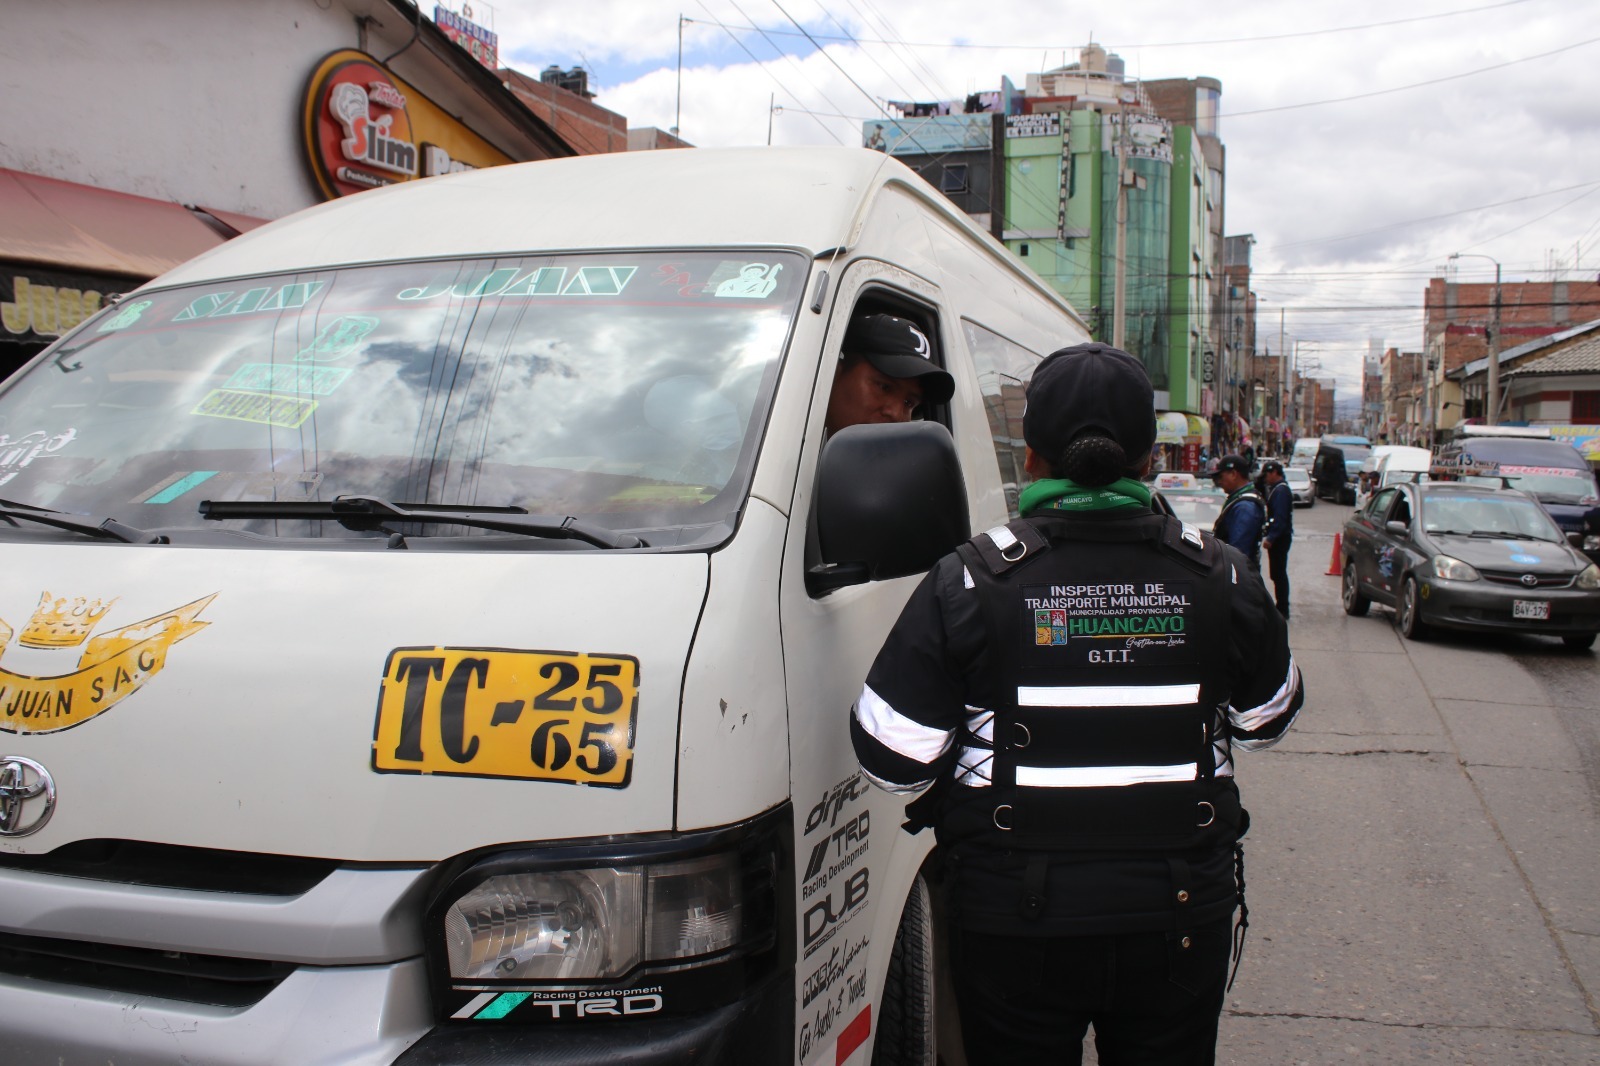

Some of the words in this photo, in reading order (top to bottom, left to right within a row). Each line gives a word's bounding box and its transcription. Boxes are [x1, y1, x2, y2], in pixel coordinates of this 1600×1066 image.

[439, 7, 497, 48] HOSPEDAJE
[1007, 113, 1059, 123] HOSPEDAJE
[351, 115, 416, 173] Slim
[397, 265, 639, 300] JUAN
[171, 281, 325, 322] SAN
[1459, 452, 1473, 466] 13
[1025, 598, 1107, 608] TRANSPORTE
[1111, 595, 1190, 606] MUNICIPAL
[1051, 584, 1134, 596] INSPECTOR
[1145, 583, 1164, 594] DE
[1070, 616, 1184, 635] HUANCAYO
[1089, 650, 1135, 663] G.T.T.
[6, 688, 73, 718] JUAN
[533, 661, 623, 714] 25
[530, 719, 618, 775] 65
[831, 809, 870, 857] TRD
[802, 872, 827, 901] Racing
[828, 839, 869, 881] Development
[803, 867, 870, 948] DUB
[533, 991, 576, 1000] Racing
[578, 984, 663, 998] Development
[802, 962, 828, 1010] HKS
[532, 994, 663, 1019] TRD
